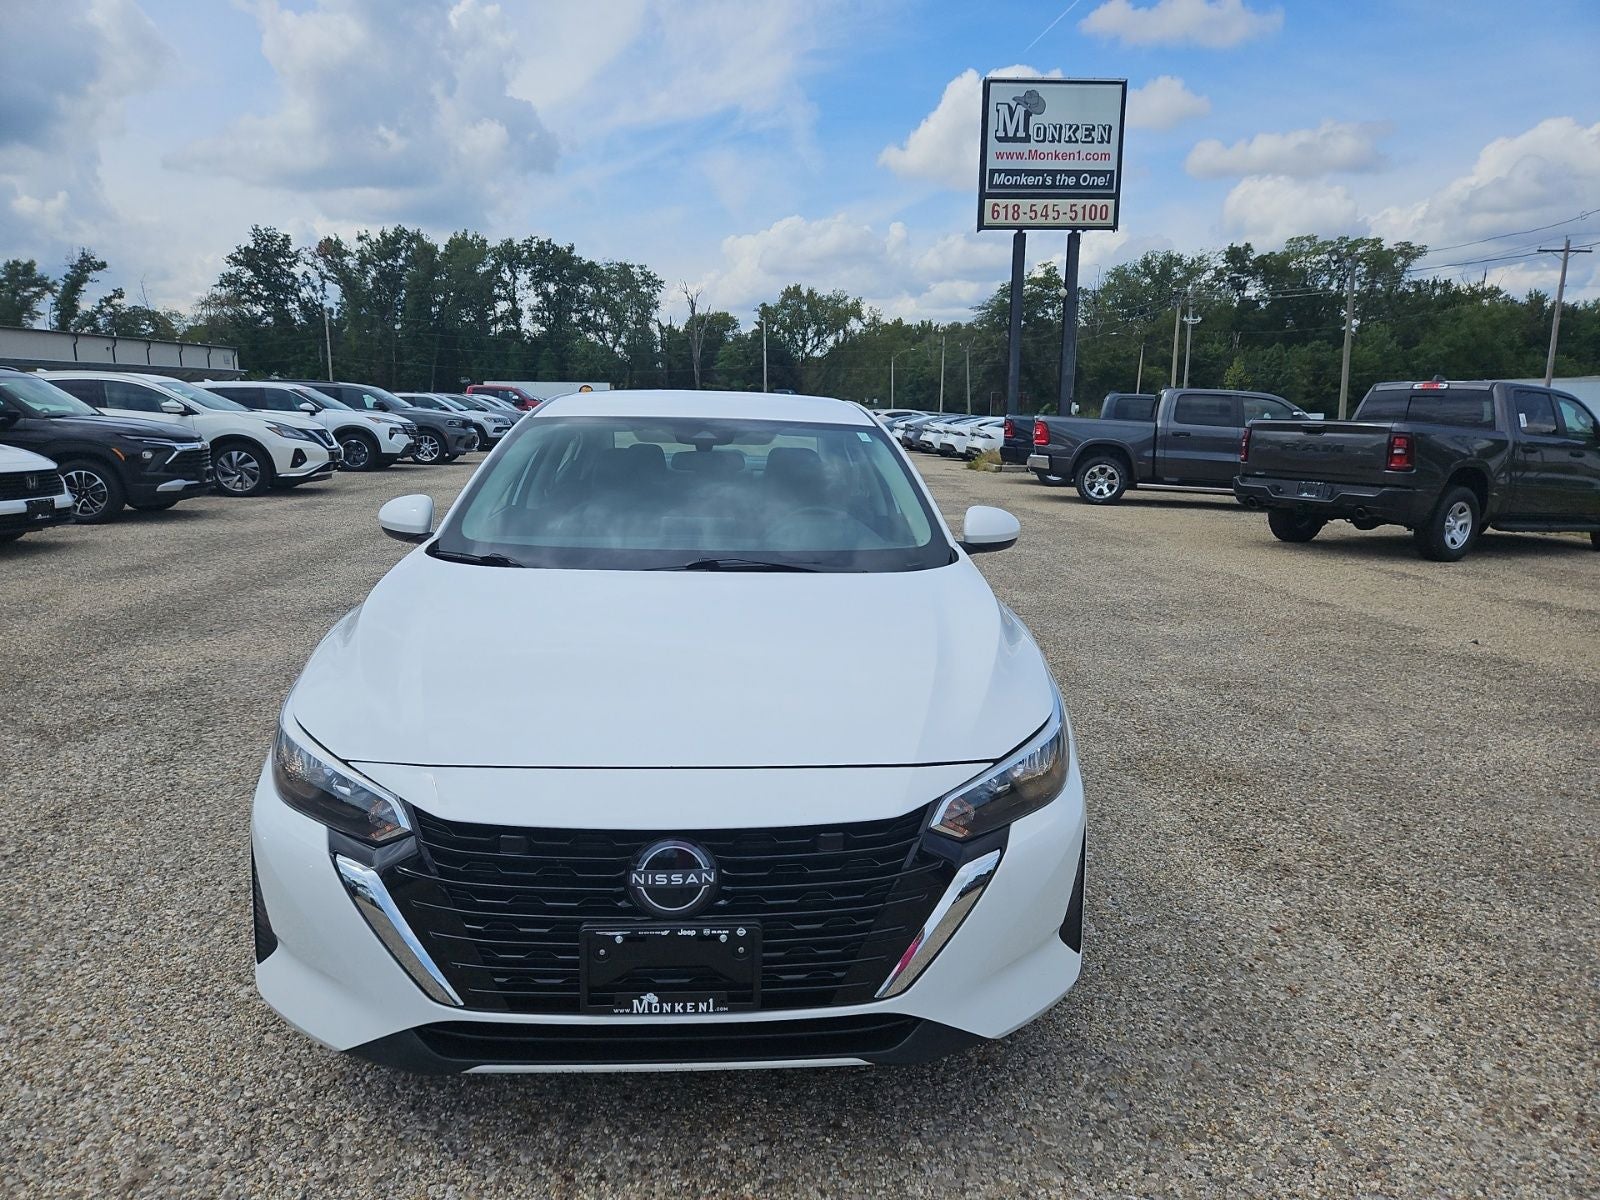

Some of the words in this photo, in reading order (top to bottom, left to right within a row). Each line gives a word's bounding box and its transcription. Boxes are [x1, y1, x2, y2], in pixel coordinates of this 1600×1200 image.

[995, 102, 1113, 144] MONKEN
[995, 150, 1111, 161] www.Monken1.com
[993, 173, 1052, 185] Monken's
[1055, 174, 1076, 185] the
[1080, 174, 1110, 185] One!
[991, 203, 1109, 221] 618-545-5100
[632, 872, 714, 885] NISSAN
